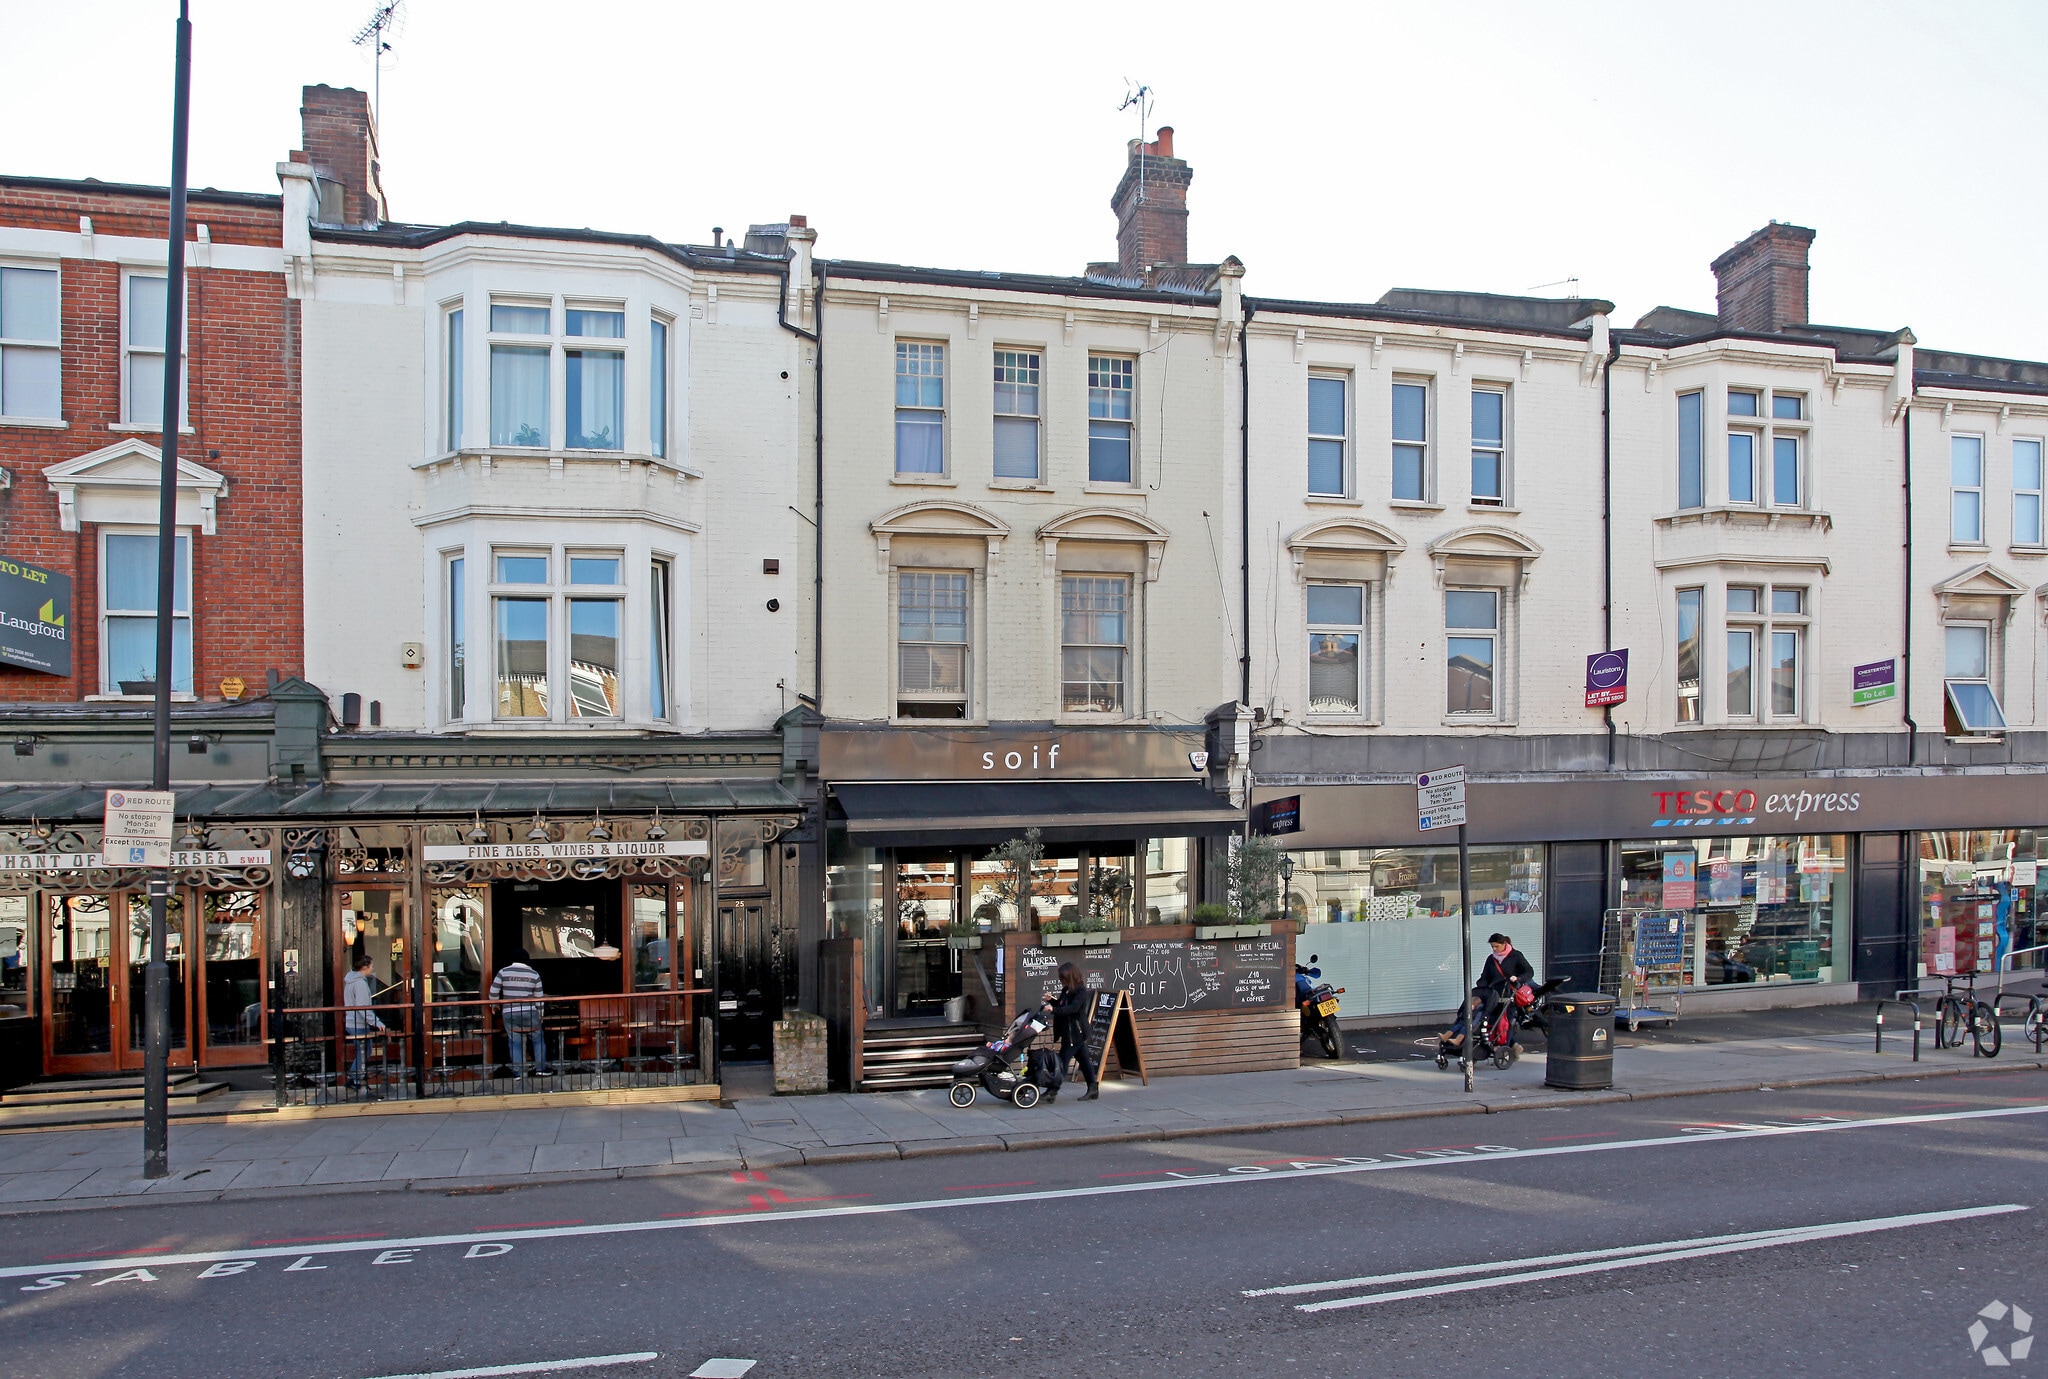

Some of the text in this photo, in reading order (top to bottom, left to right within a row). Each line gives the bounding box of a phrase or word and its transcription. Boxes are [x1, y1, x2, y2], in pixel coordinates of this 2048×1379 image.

[0, 561, 48, 584] TO LET
[0, 611, 65, 640] Langford
[1593, 666, 1621, 675] Lauristons
[1863, 689, 1887, 699] To Let
[982, 743, 1060, 770] soif
[1434, 785, 1457, 793] stopping
[1271, 799, 1298, 814] TESCO
[1651, 789, 1861, 821] TESCO express
[1272, 818, 1294, 830] express
[123, 827, 156, 835] 7am-7pm
[132, 839, 170, 847] 10am-4pm
[468, 846, 499, 858] FINE
[552, 844, 595, 855] WINES
[601, 844, 611, 855] &
[616, 842, 666, 855] LIQUOR
[1712, 863, 1728, 873] £40
[1398, 872, 1417, 881] Frozen
[735, 900, 745, 908] 25
[1234, 942, 1282, 952] LUNCH SPECIAL
[1022, 956, 1058, 967] ALLPRESS
[1128, 981, 1167, 996] SOIF
[1234, 985, 1250, 993] GLASS
[1165, 1144, 1519, 1180] LOADING
